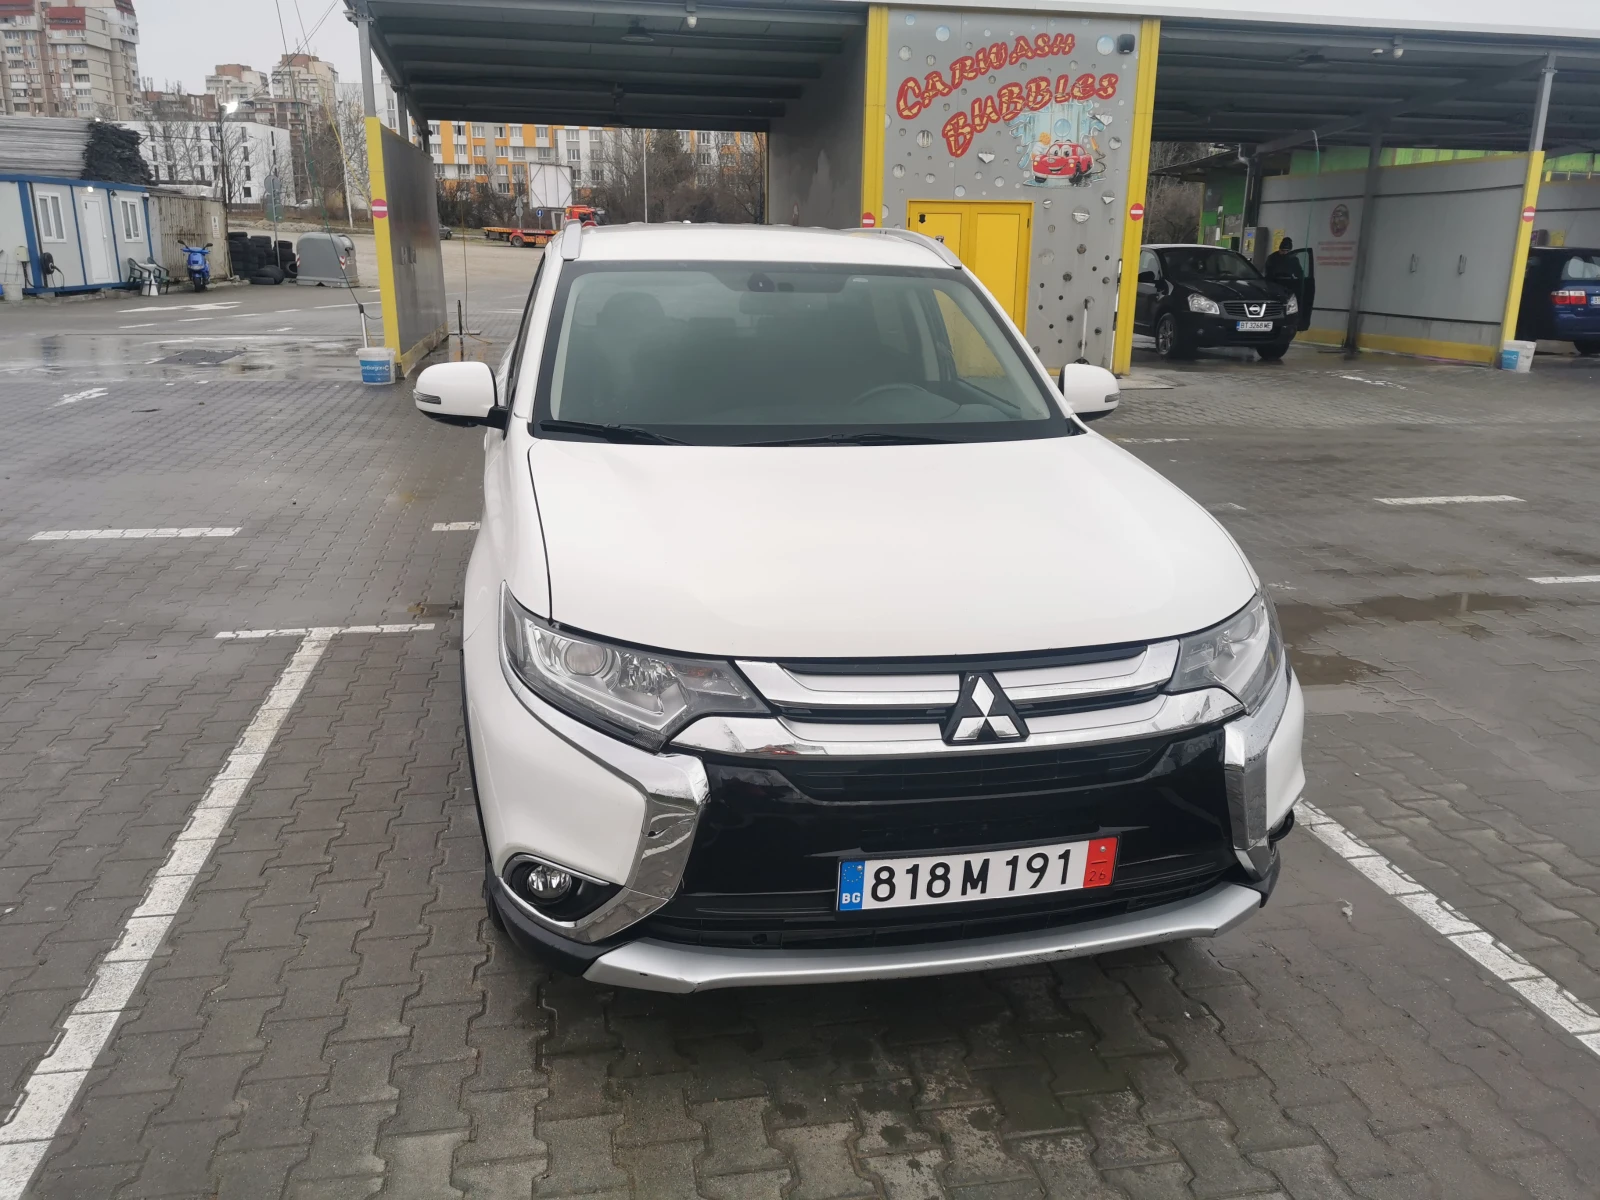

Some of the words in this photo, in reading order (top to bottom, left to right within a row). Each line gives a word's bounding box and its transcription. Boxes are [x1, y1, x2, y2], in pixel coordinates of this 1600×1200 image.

[896, 33, 1076, 120] CARWASH
[942, 73, 1118, 158] BUBBLES
[841, 892, 861, 904] BG
[870, 861, 951, 902] 818
[960, 858, 990, 896] M
[1005, 848, 1072, 892] 191
[1088, 868, 1107, 882] 26
